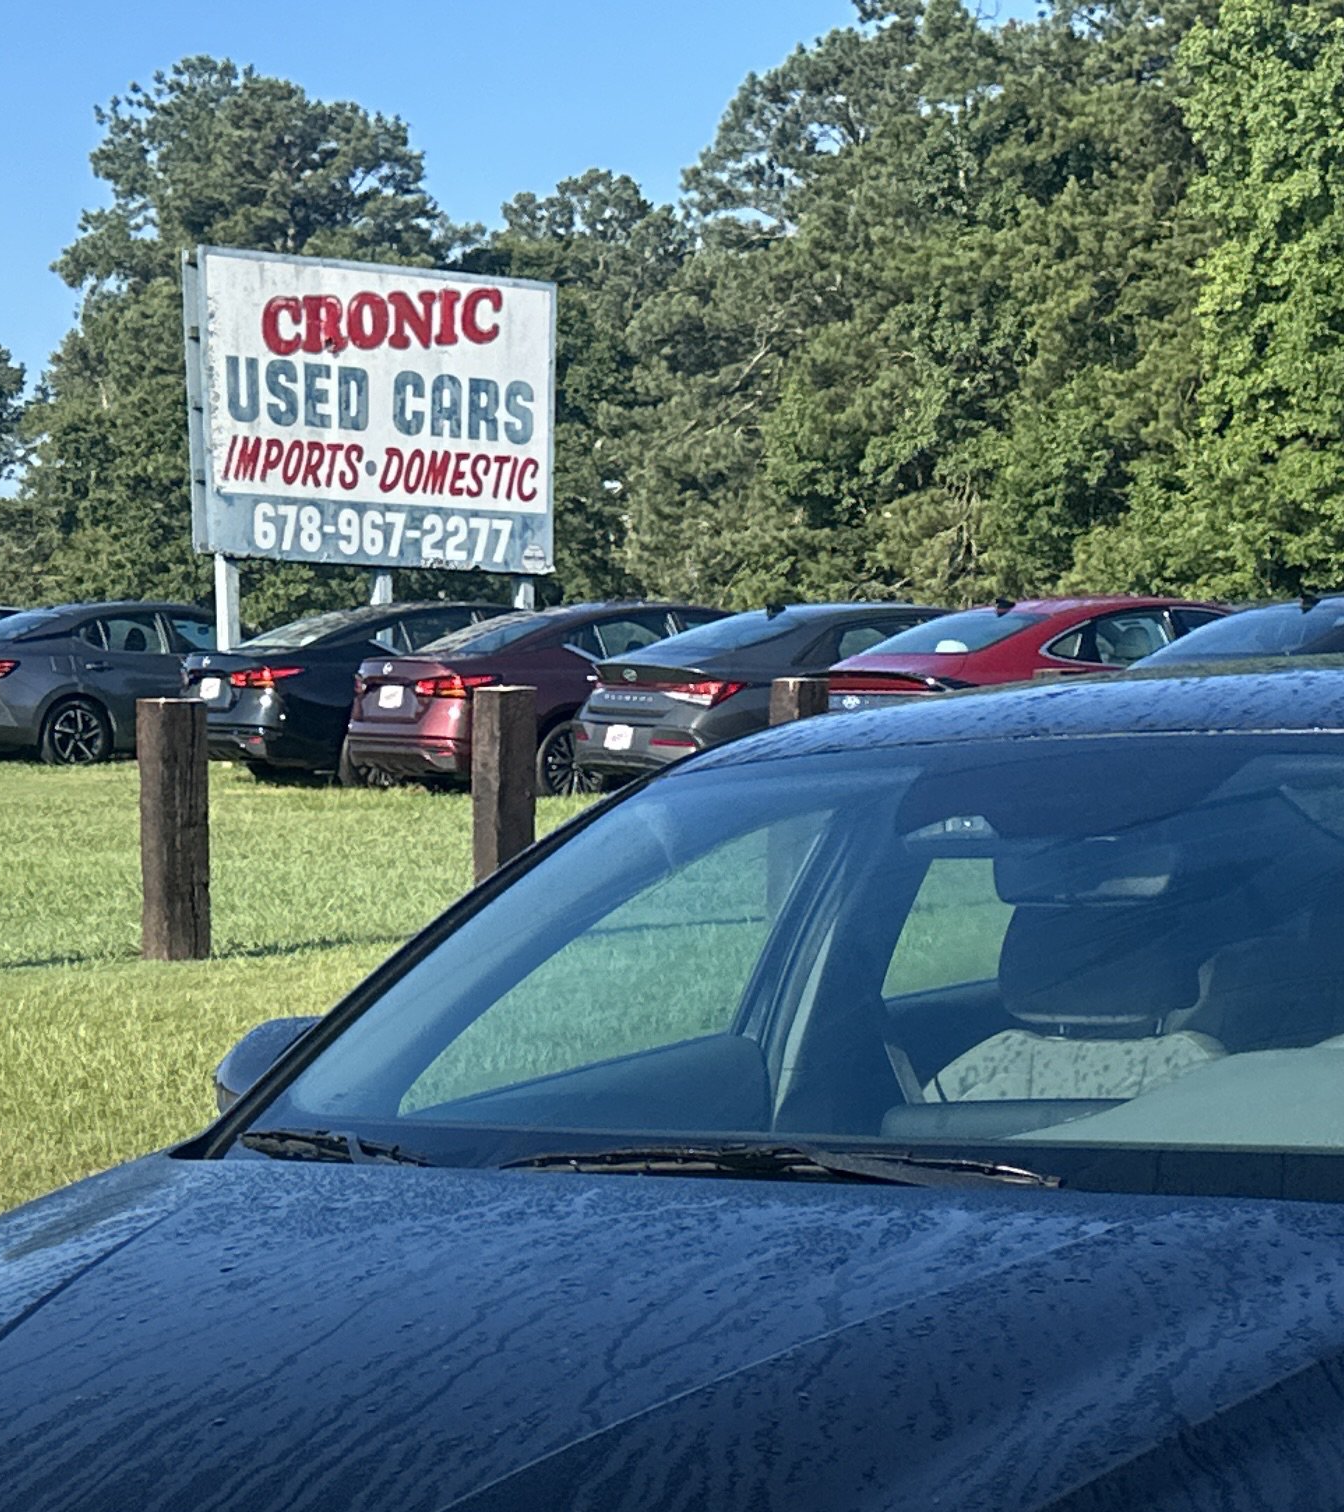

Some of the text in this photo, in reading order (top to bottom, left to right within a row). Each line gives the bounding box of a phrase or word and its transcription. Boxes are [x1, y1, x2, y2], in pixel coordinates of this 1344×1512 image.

[262, 287, 503, 356] CRONIC
[225, 355, 535, 445] USED CARS
[253, 502, 513, 563] 678-967-2277
